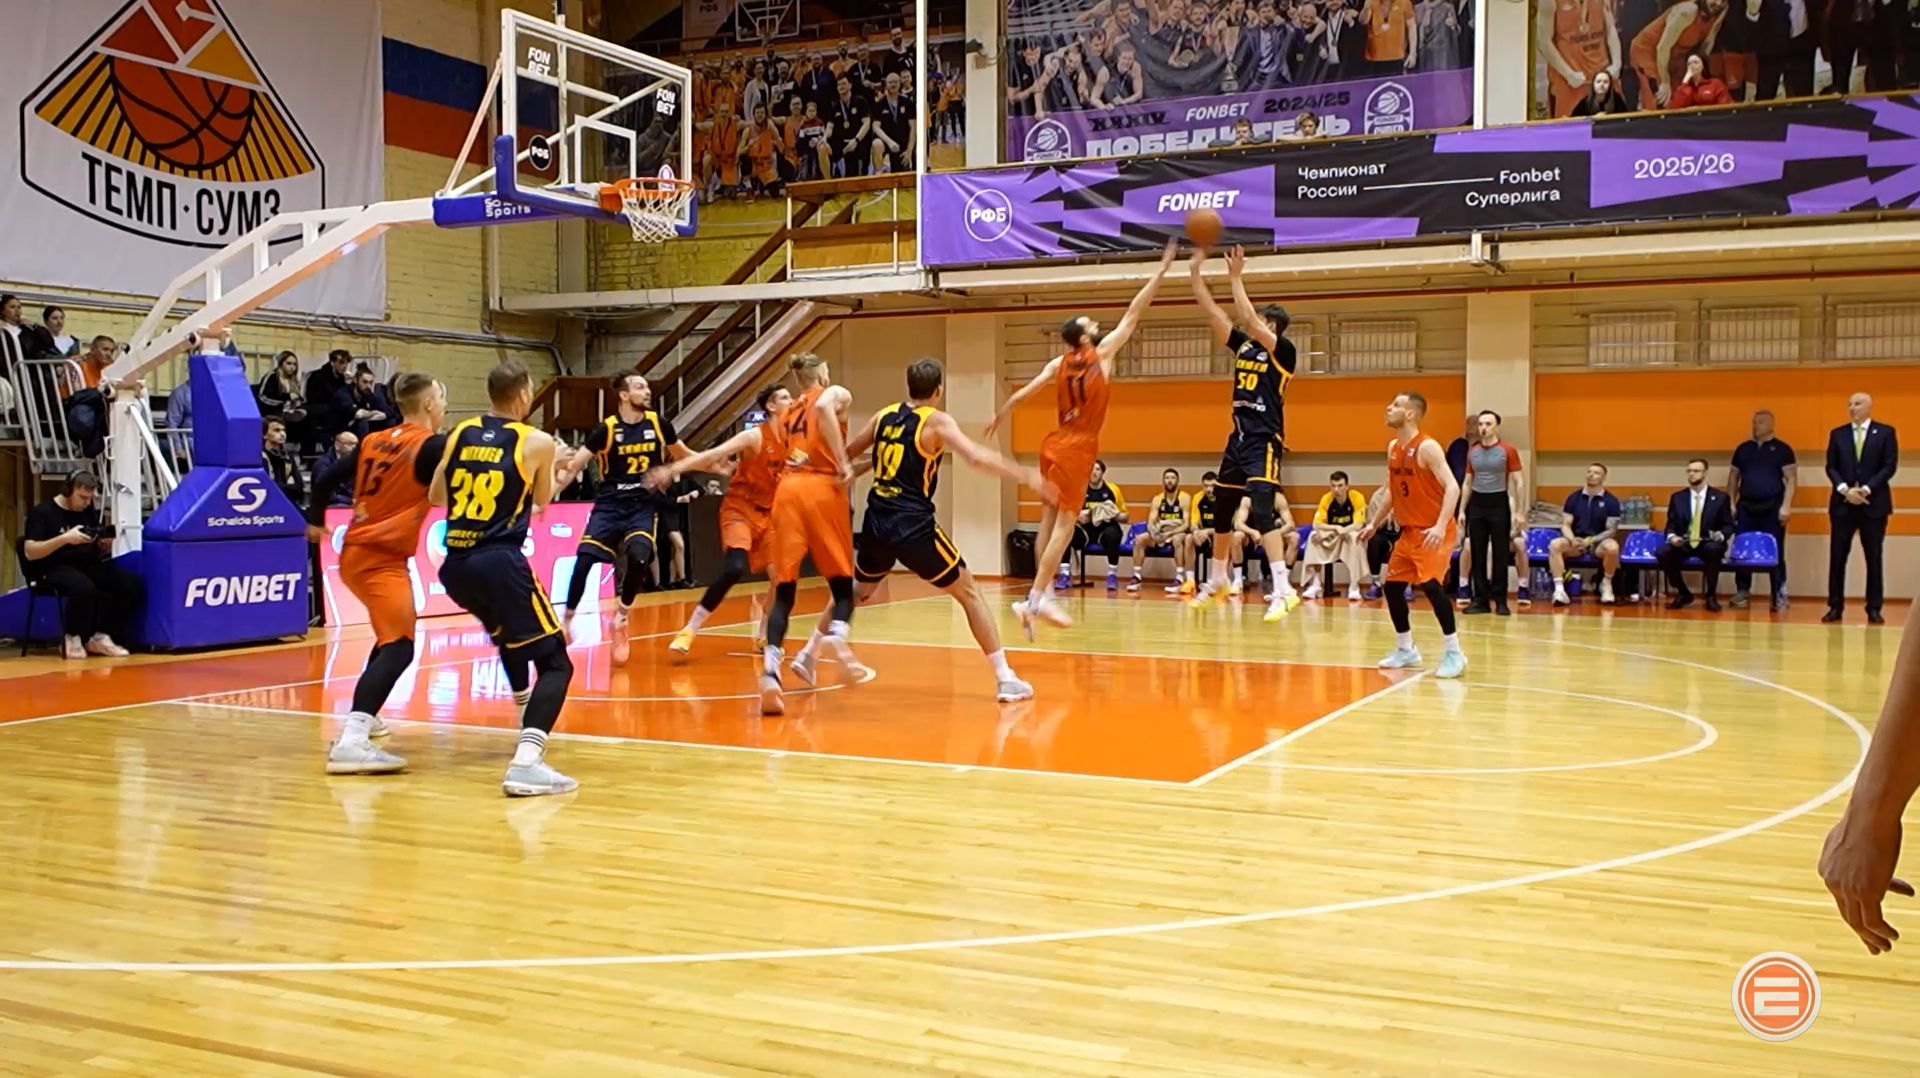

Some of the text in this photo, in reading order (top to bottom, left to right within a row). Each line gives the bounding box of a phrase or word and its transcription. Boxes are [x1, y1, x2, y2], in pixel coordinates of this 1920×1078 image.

[527, 47, 551, 65] FON
[656, 88, 676, 104] FON
[656, 101, 676, 116] BET
[1185, 102, 1249, 122] FONBET
[1264, 91, 1351, 114] 2024/25
[1298, 163, 1387, 181] Чемпионат
[1634, 153, 1735, 179] 2025/26
[1500, 167, 1561, 185] Fonbet
[1298, 184, 1358, 199] России
[1465, 188, 1561, 208] Суперлига
[1158, 190, 1240, 213] FONBET
[970, 207, 1007, 223] РФБ
[1236, 372, 1259, 391] 50
[627, 455, 650, 474] 23
[875, 441, 905, 480] 19
[449, 468, 505, 521] 38
[1400, 480, 1410, 498] 3
[207, 515, 285, 527] Schelde Sports
[184, 573, 302, 607] FONBET
